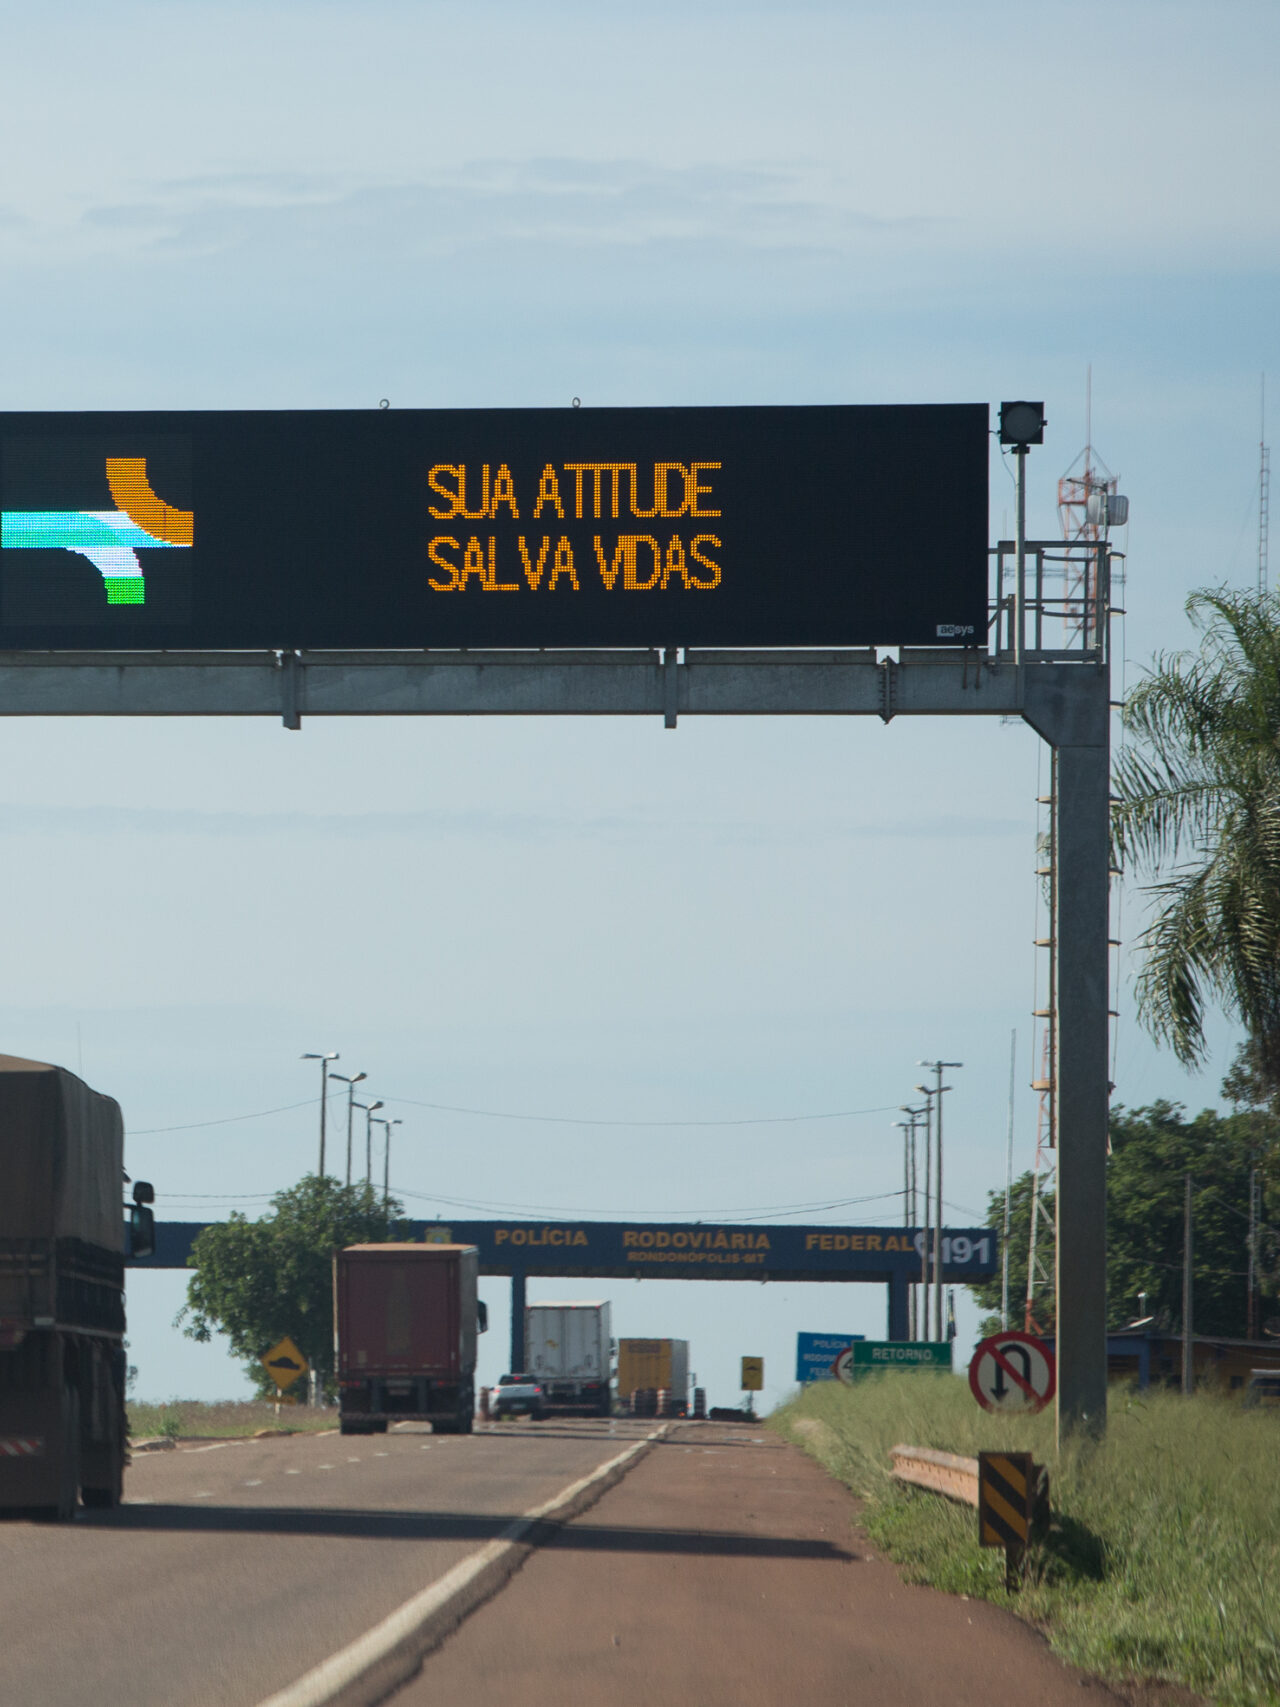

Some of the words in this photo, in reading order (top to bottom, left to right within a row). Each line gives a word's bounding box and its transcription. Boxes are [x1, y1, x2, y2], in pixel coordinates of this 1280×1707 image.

[428, 463, 519, 519] SUA
[533, 462, 722, 518] ATITUDE
[428, 536, 580, 591] SALVA
[594, 534, 722, 590] VIDAS
[494, 1227, 589, 1246] POLÍCIA
[623, 1229, 770, 1249] RODOVIÁRIA
[805, 1233, 915, 1251] FEDERAL
[872, 1347, 932, 1361] RETORNO
